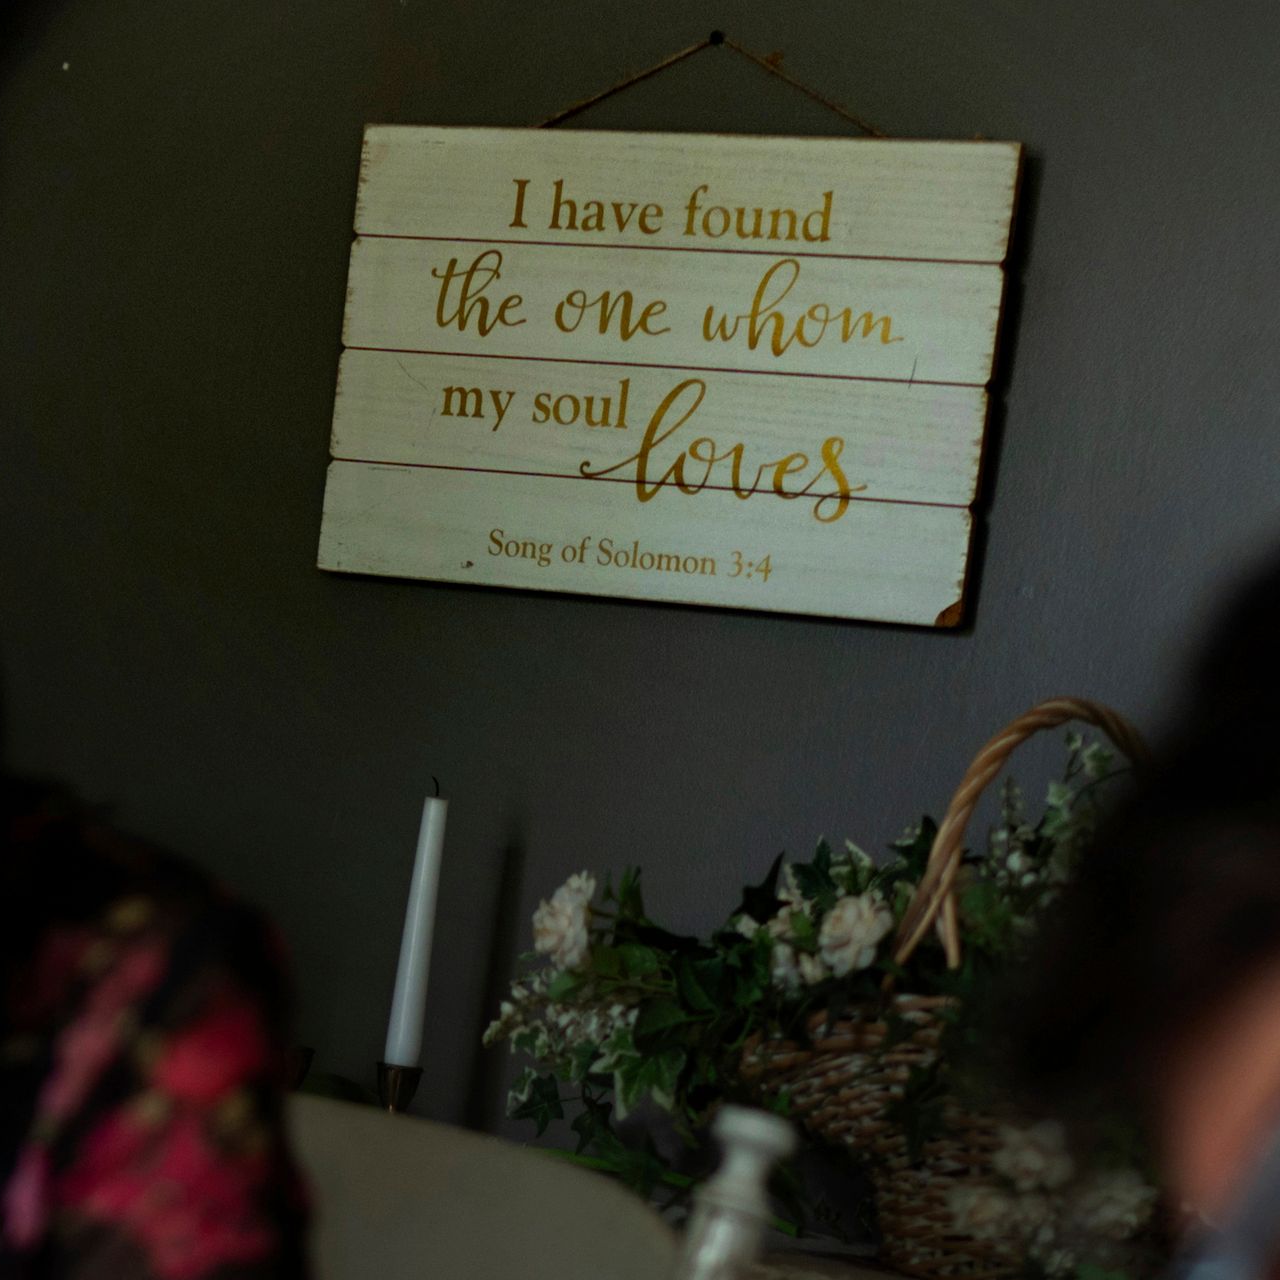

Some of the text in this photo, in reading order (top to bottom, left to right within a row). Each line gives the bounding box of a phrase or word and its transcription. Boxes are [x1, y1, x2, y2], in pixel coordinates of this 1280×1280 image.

[508, 179, 833, 242] I have found
[431, 250, 905, 357] the one whom
[440, 378, 867, 524] my soul loves
[487, 528, 773, 582] Song of Solomon 3:4
